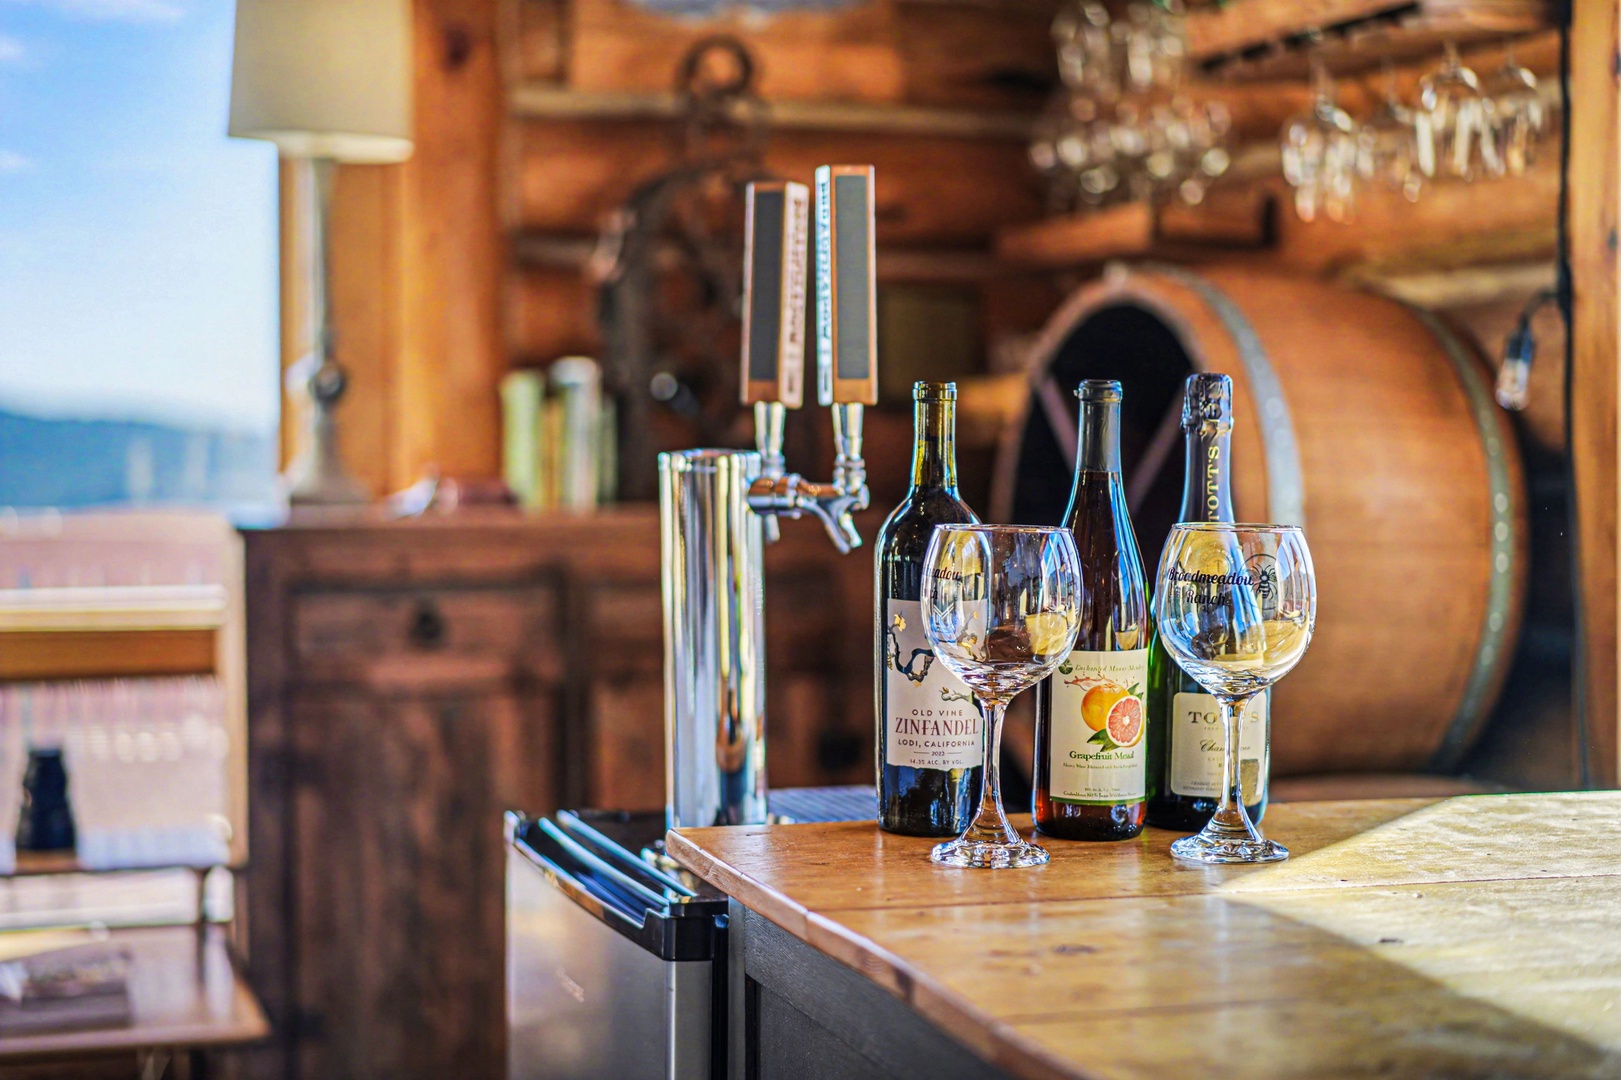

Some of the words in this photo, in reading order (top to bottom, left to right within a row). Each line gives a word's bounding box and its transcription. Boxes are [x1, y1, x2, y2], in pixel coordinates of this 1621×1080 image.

[1207, 446, 1219, 522] TOTT'S
[1186, 590, 1227, 606] Ranch
[895, 717, 979, 736] ZINFANDEL
[898, 739, 921, 748] LODI,
[924, 740, 975, 748] CALIFORNIA
[1069, 751, 1112, 761] Grapefruit
[1114, 751, 1135, 760] Mead
